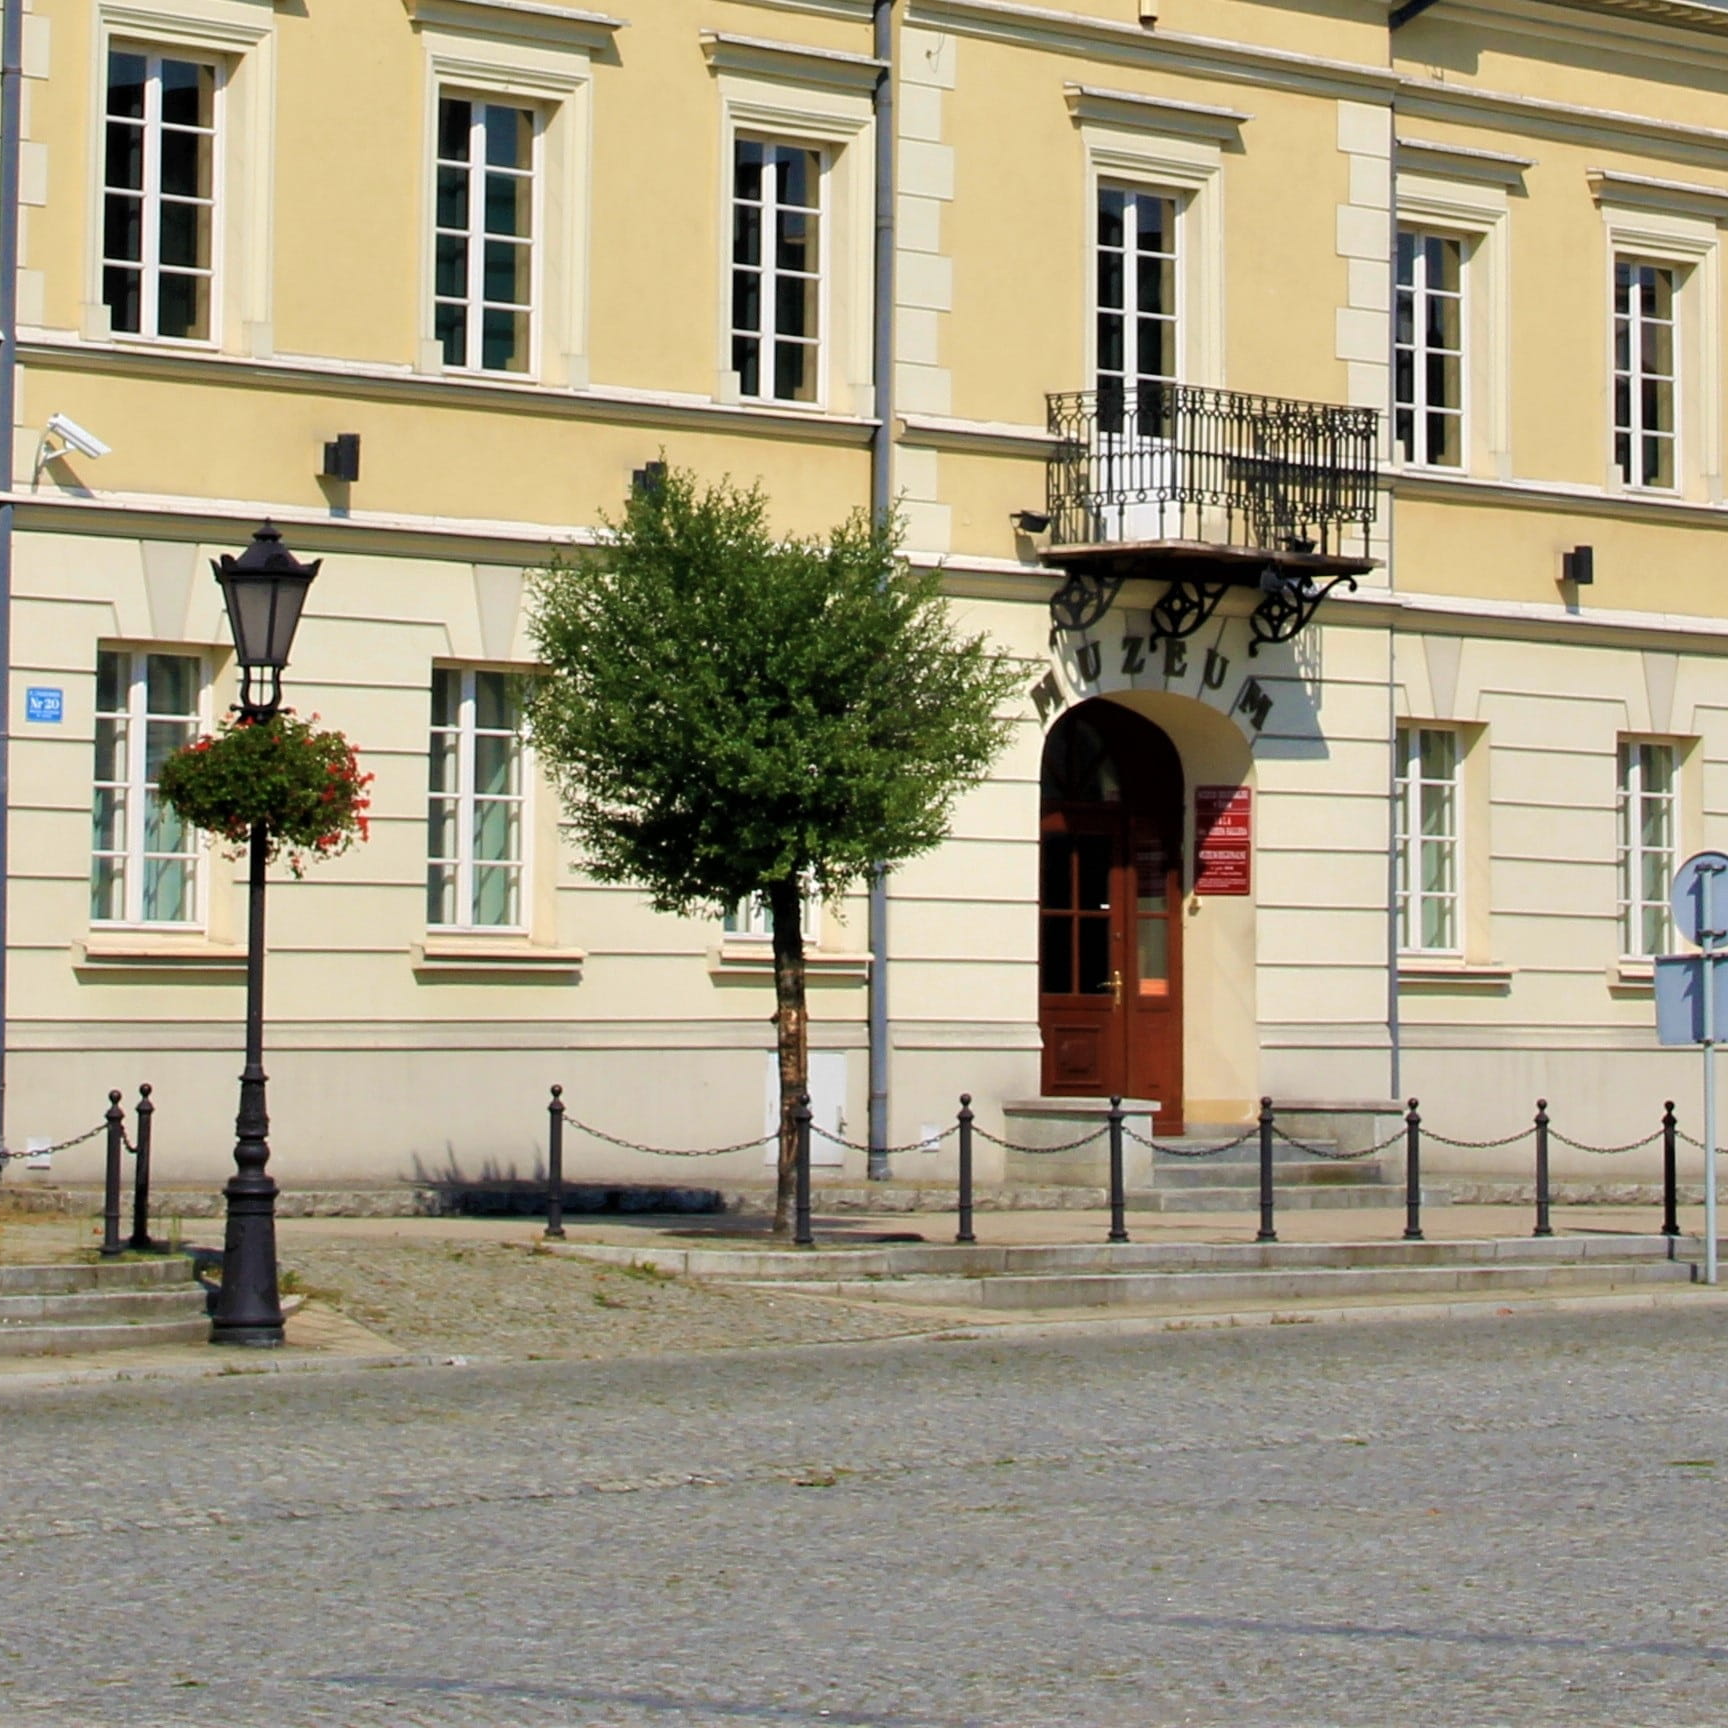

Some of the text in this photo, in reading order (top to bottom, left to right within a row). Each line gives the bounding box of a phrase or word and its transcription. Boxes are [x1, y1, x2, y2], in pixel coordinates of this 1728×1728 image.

[30, 696, 60, 709] Nr 20
[1030, 636, 1273, 731] MUZEUM
